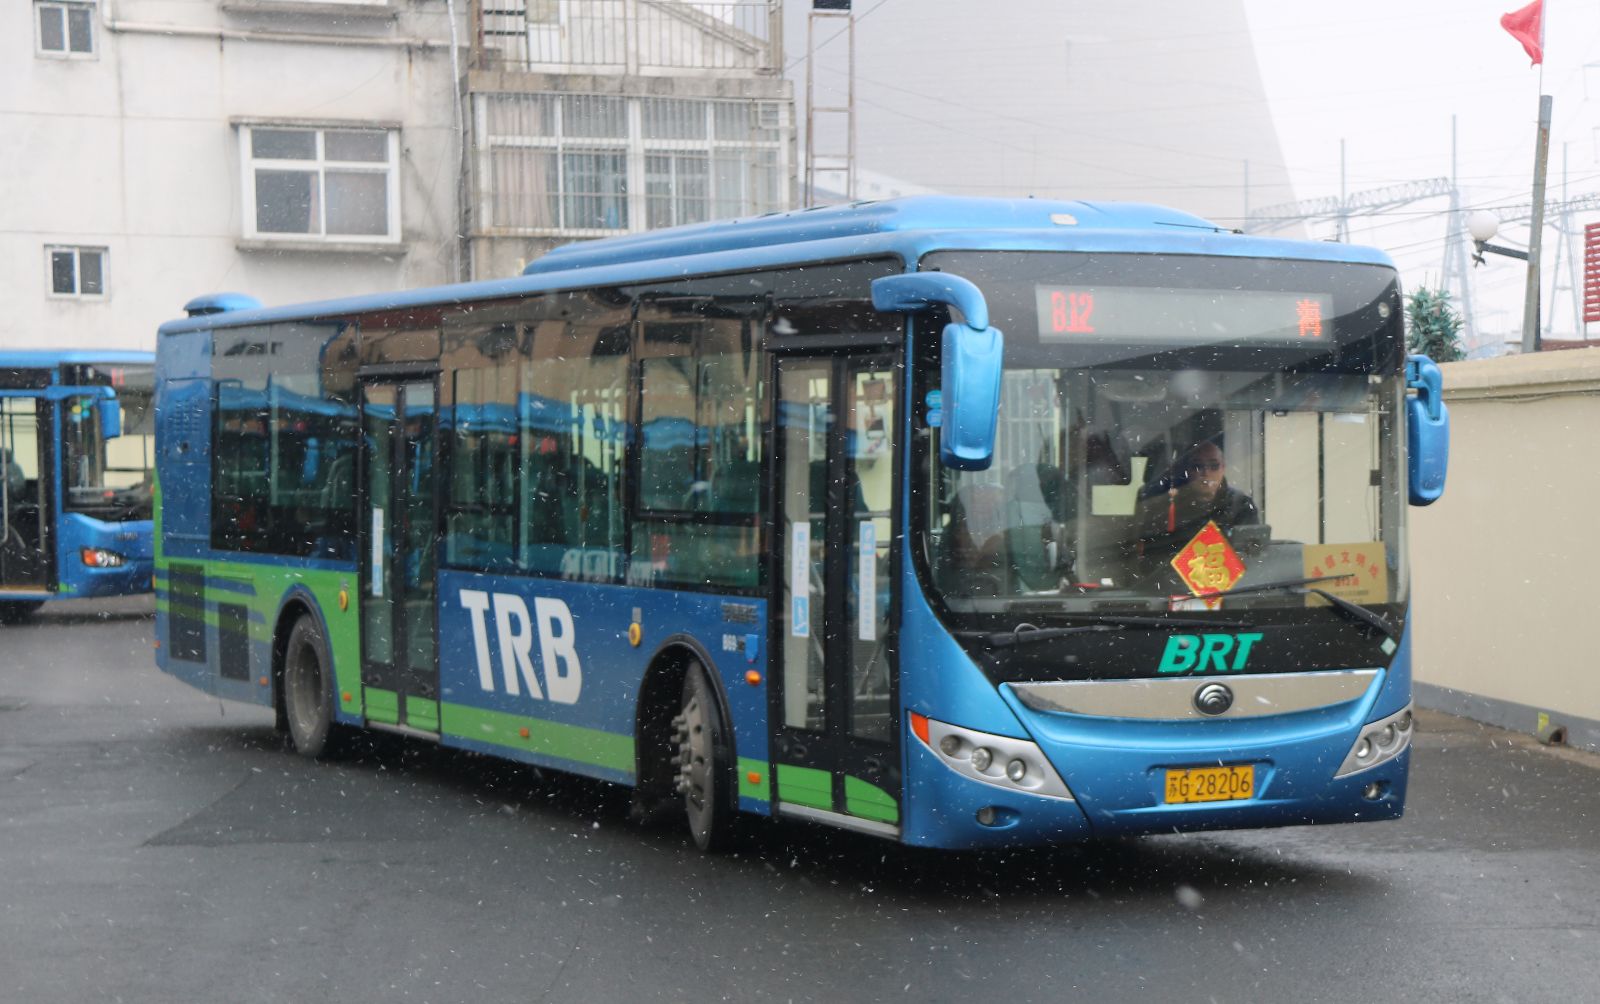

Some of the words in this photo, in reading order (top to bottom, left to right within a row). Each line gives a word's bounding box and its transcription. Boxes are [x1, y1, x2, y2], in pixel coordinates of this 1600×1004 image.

[1051, 291, 1096, 333] B12
[1188, 540, 1230, 591] 福
[459, 588, 583, 705] TRB
[1157, 632, 1264, 673] BRT
